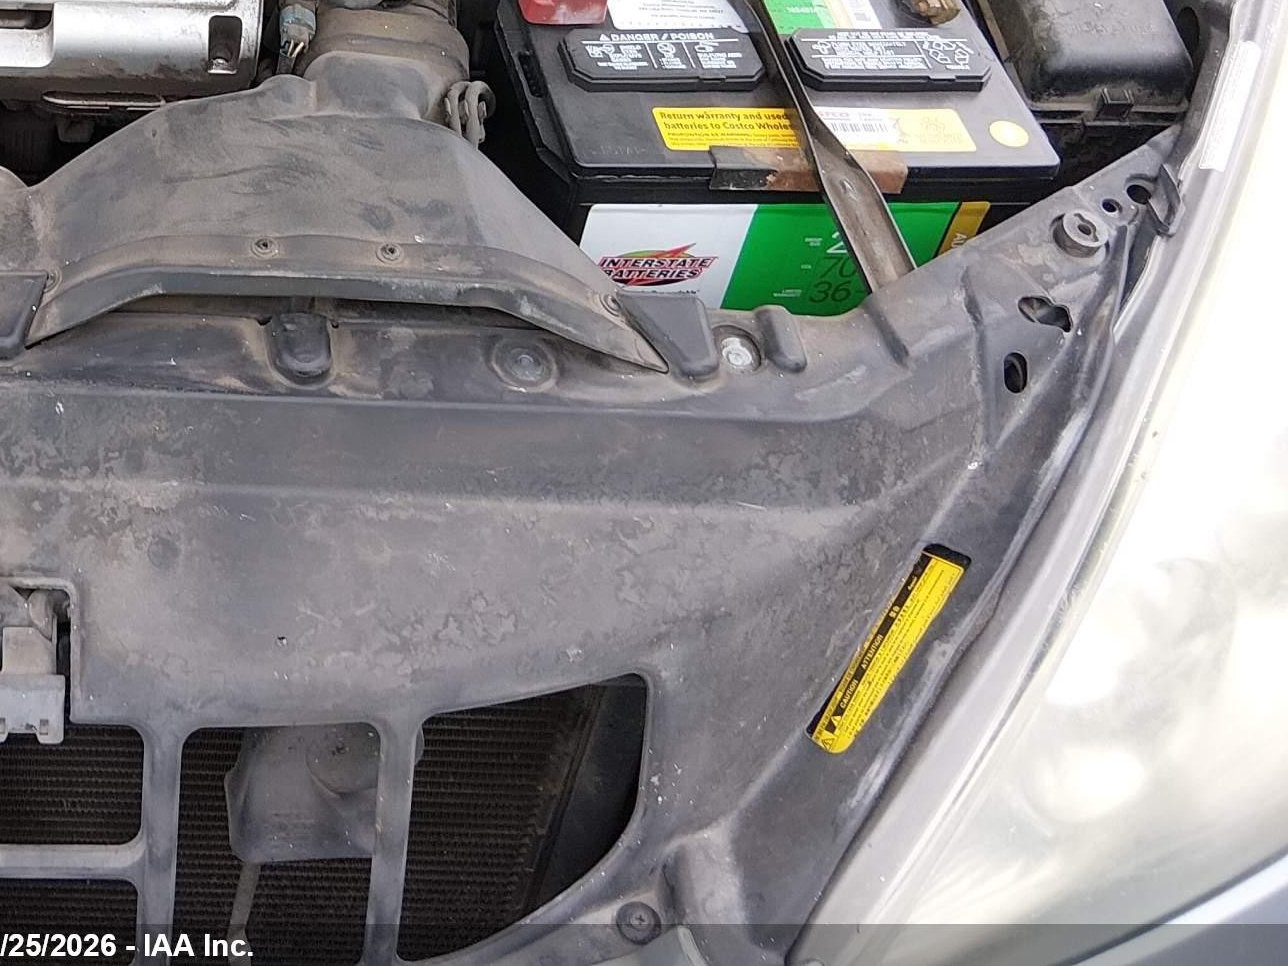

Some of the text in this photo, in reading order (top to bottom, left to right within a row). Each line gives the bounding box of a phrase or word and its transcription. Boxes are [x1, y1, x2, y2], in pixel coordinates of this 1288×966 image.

[611, 33, 659, 41] DANGER
[670, 32, 714, 40] POISON
[696, 111, 741, 121] warranty
[743, 112, 762, 120] and
[722, 121, 754, 129] Costco
[600, 257, 713, 268] INTERSTATE
[603, 269, 700, 279] BATTERIES
[840, 679, 859, 709] CAUTION
[861, 634, 884, 670] ATTENTION
